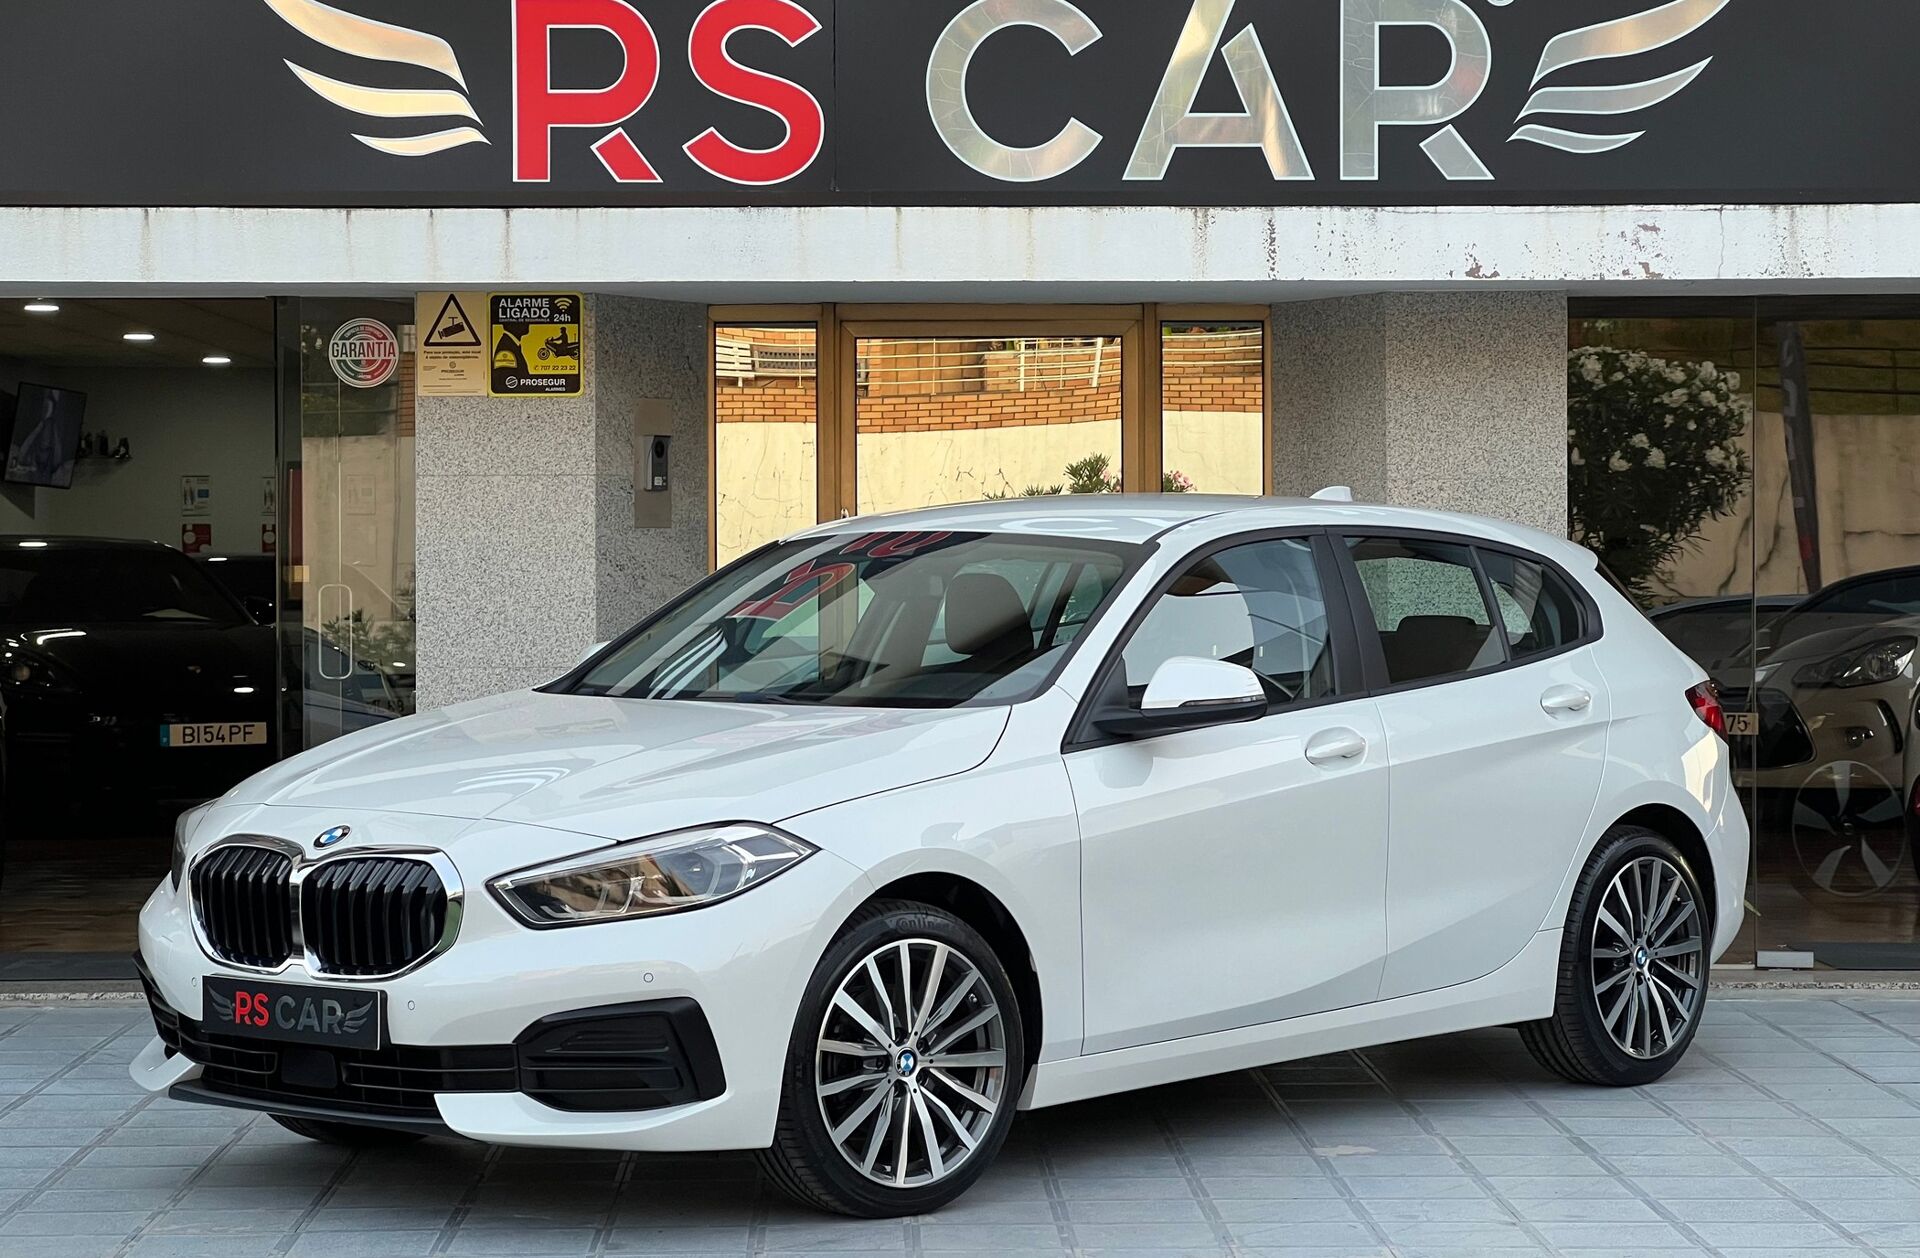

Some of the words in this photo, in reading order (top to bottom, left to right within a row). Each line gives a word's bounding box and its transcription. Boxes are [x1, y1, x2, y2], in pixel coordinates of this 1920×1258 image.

[513, 0, 825, 185] RS
[926, 0, 1495, 182] CAR
[500, 298, 550, 307] ALARME
[499, 308, 550, 318] LIGADO
[553, 314, 571, 322] 24h
[332, 341, 396, 358] GARANTIA
[520, 378, 566, 386] PROSEGUR
[235, 991, 270, 1027] RS
[275, 995, 342, 1035] CAR
